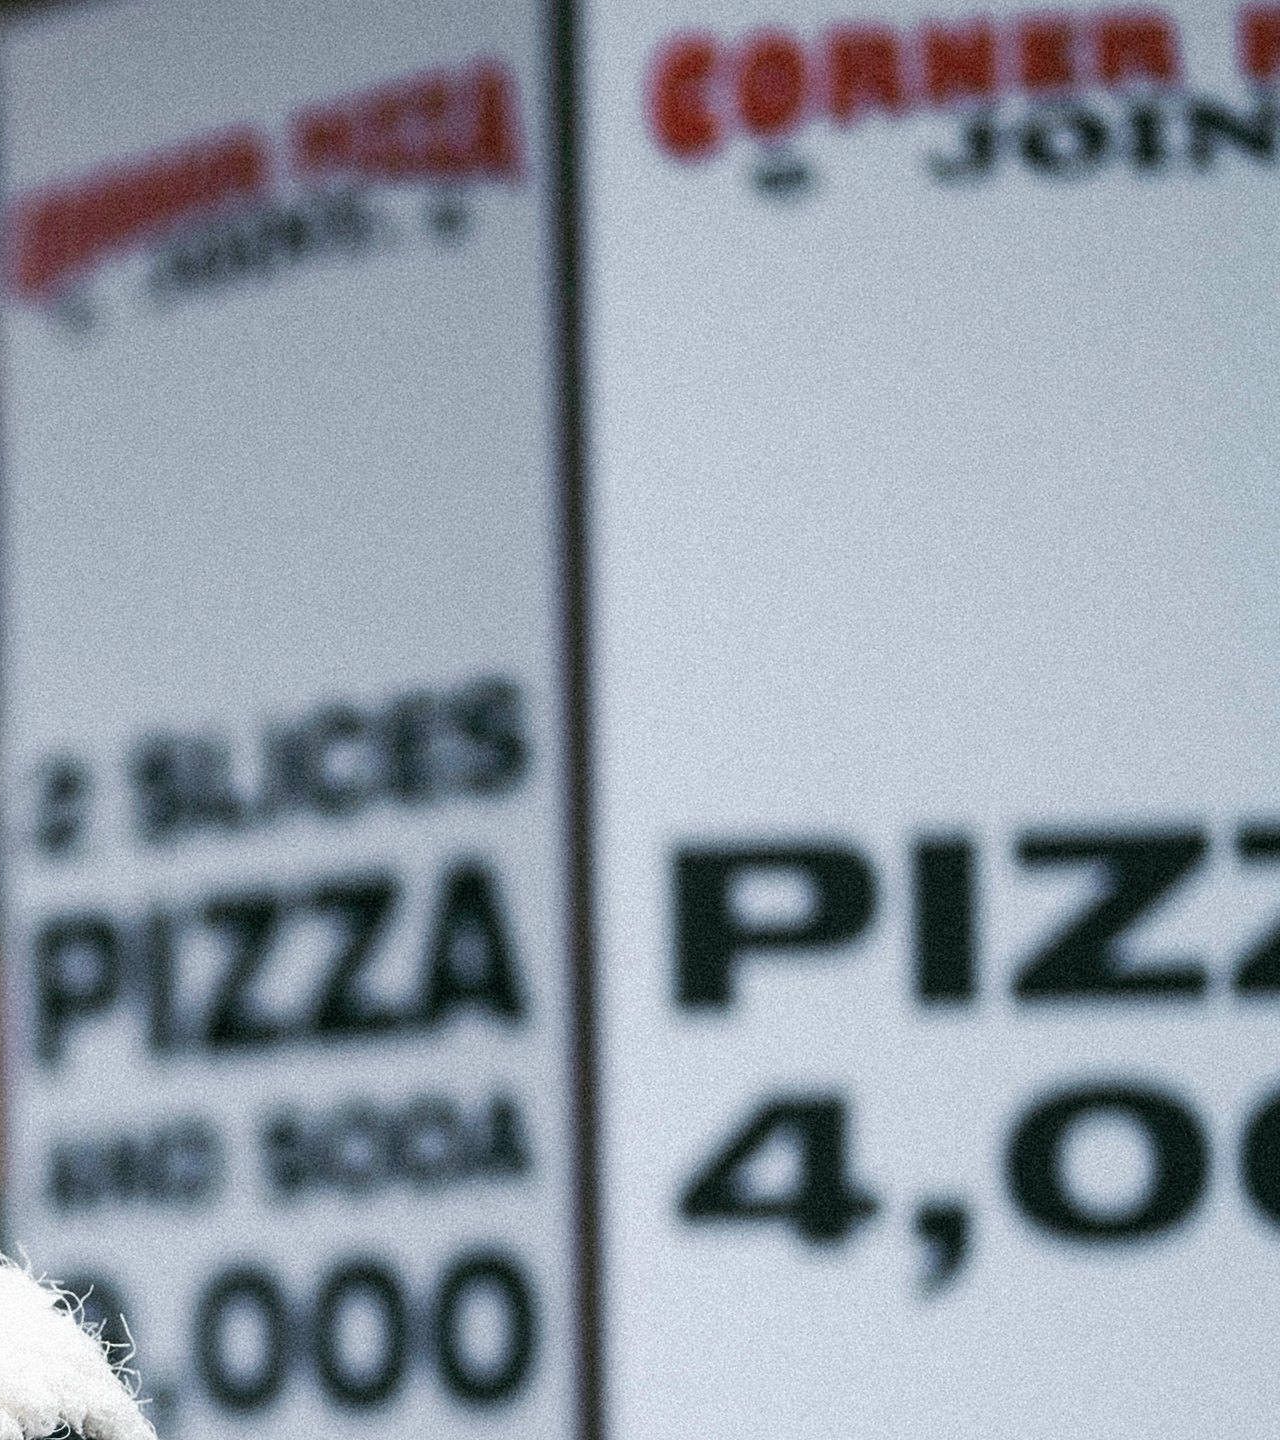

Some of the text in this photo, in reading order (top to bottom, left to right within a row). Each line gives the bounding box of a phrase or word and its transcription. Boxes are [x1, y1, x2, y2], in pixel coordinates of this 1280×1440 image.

[652, 10, 1180, 160] CORNER
[130, 672, 531, 845] SLICES
[34, 860, 528, 1060] PIZZA
[671, 822, 1280, 1012] PIZ
[676, 1075, 1280, 1297] 4,0
